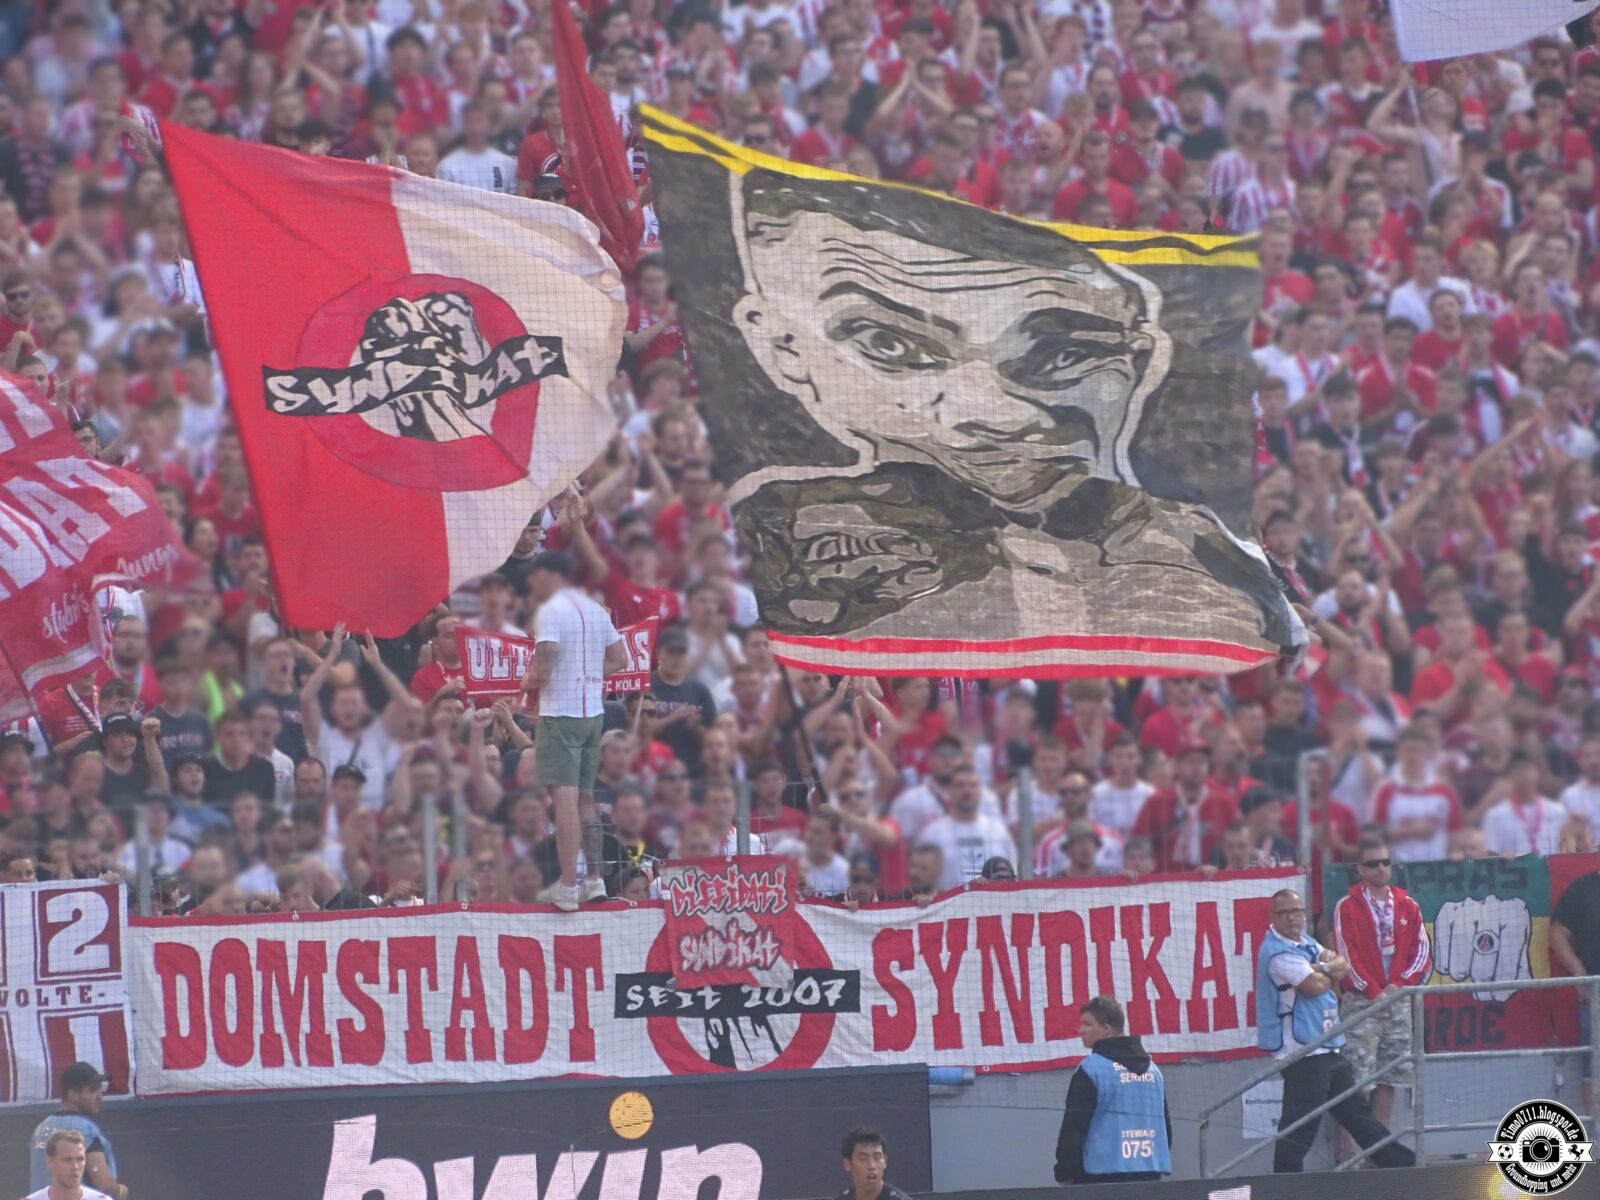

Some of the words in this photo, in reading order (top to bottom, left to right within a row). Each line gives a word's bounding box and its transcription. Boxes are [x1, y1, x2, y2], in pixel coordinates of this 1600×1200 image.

[615, 677, 641, 691] KÖLN
[46, 891, 110, 973] 2
[154, 933, 604, 1070] DOMSTADT
[743, 976, 847, 1010] 2007
[1121, 1140, 1152, 1159] 075
